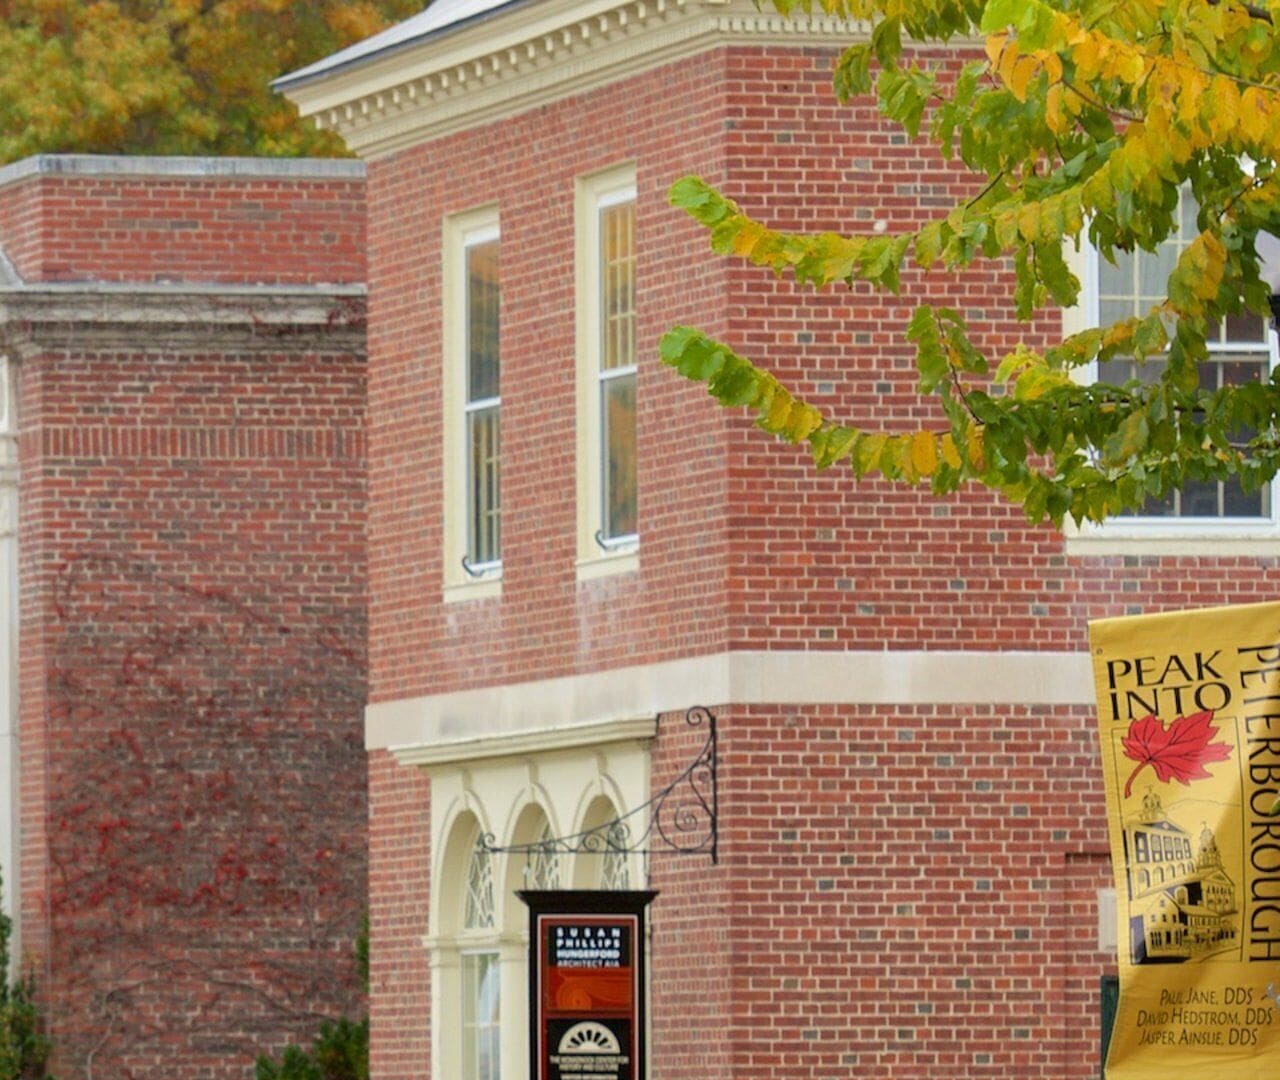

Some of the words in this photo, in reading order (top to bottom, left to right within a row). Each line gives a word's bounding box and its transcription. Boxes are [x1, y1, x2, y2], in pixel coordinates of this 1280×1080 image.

[1106, 649, 1223, 689] PEAK
[1110, 682, 1232, 720] INTO
[556, 927, 621, 938] SUSAN
[556, 938, 621, 948] PHILLIPS
[556, 949, 621, 959] HUNGERFORD
[557, 959, 603, 968] ARCHITECT
[604, 959, 620, 968] AIA
[1186, 987, 1219, 1005] JANE,
[1224, 987, 1253, 1005] DDS
[1137, 1009, 1168, 1027] DAVID
[1172, 1008, 1241, 1026] HEDSTROM,
[1245, 1007, 1273, 1025] DDS
[1138, 1029, 1175, 1046] JASPER
[1228, 1028, 1258, 1046] DDS
